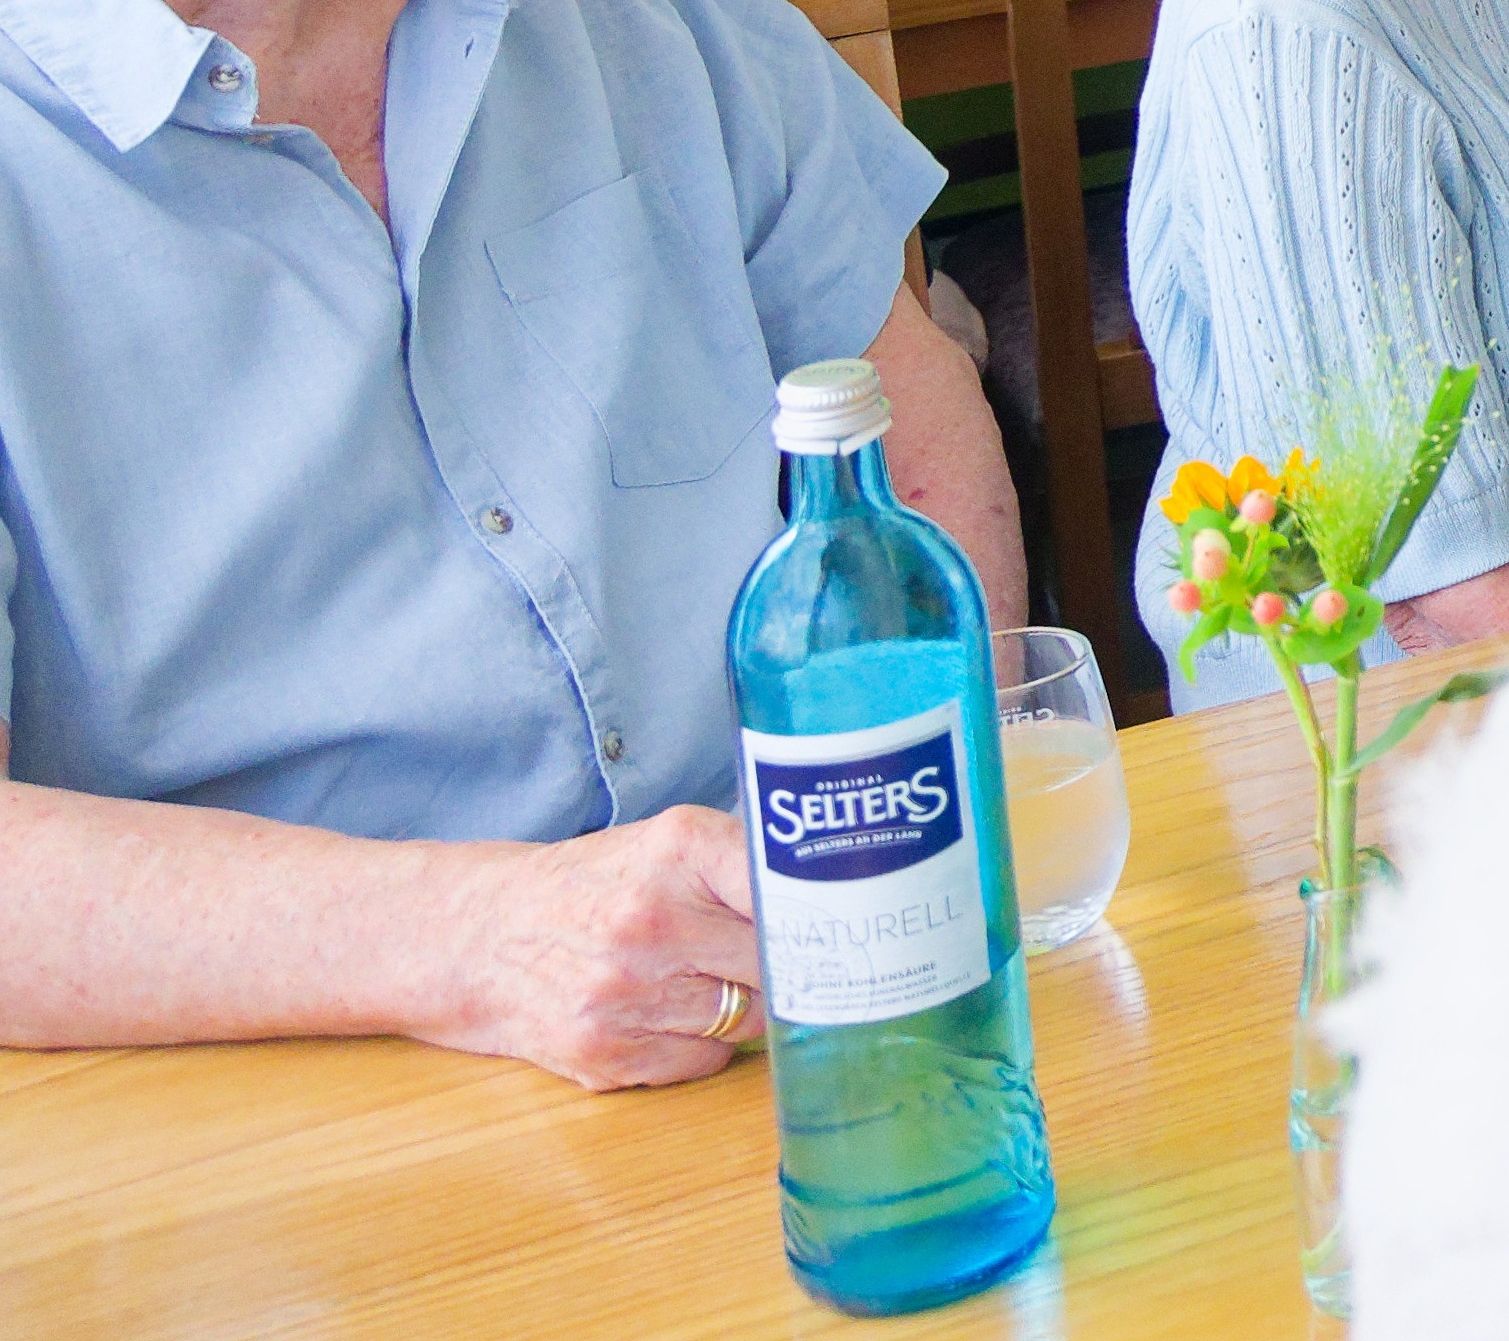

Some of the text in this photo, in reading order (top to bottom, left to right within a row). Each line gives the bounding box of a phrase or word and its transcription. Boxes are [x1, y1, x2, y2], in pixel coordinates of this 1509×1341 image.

[815, 774, 885, 792] ORIGINAL
[767, 766, 948, 844] SELTERS
[872, 832, 894, 843] DER
[782, 895, 964, 951] NATURELL
